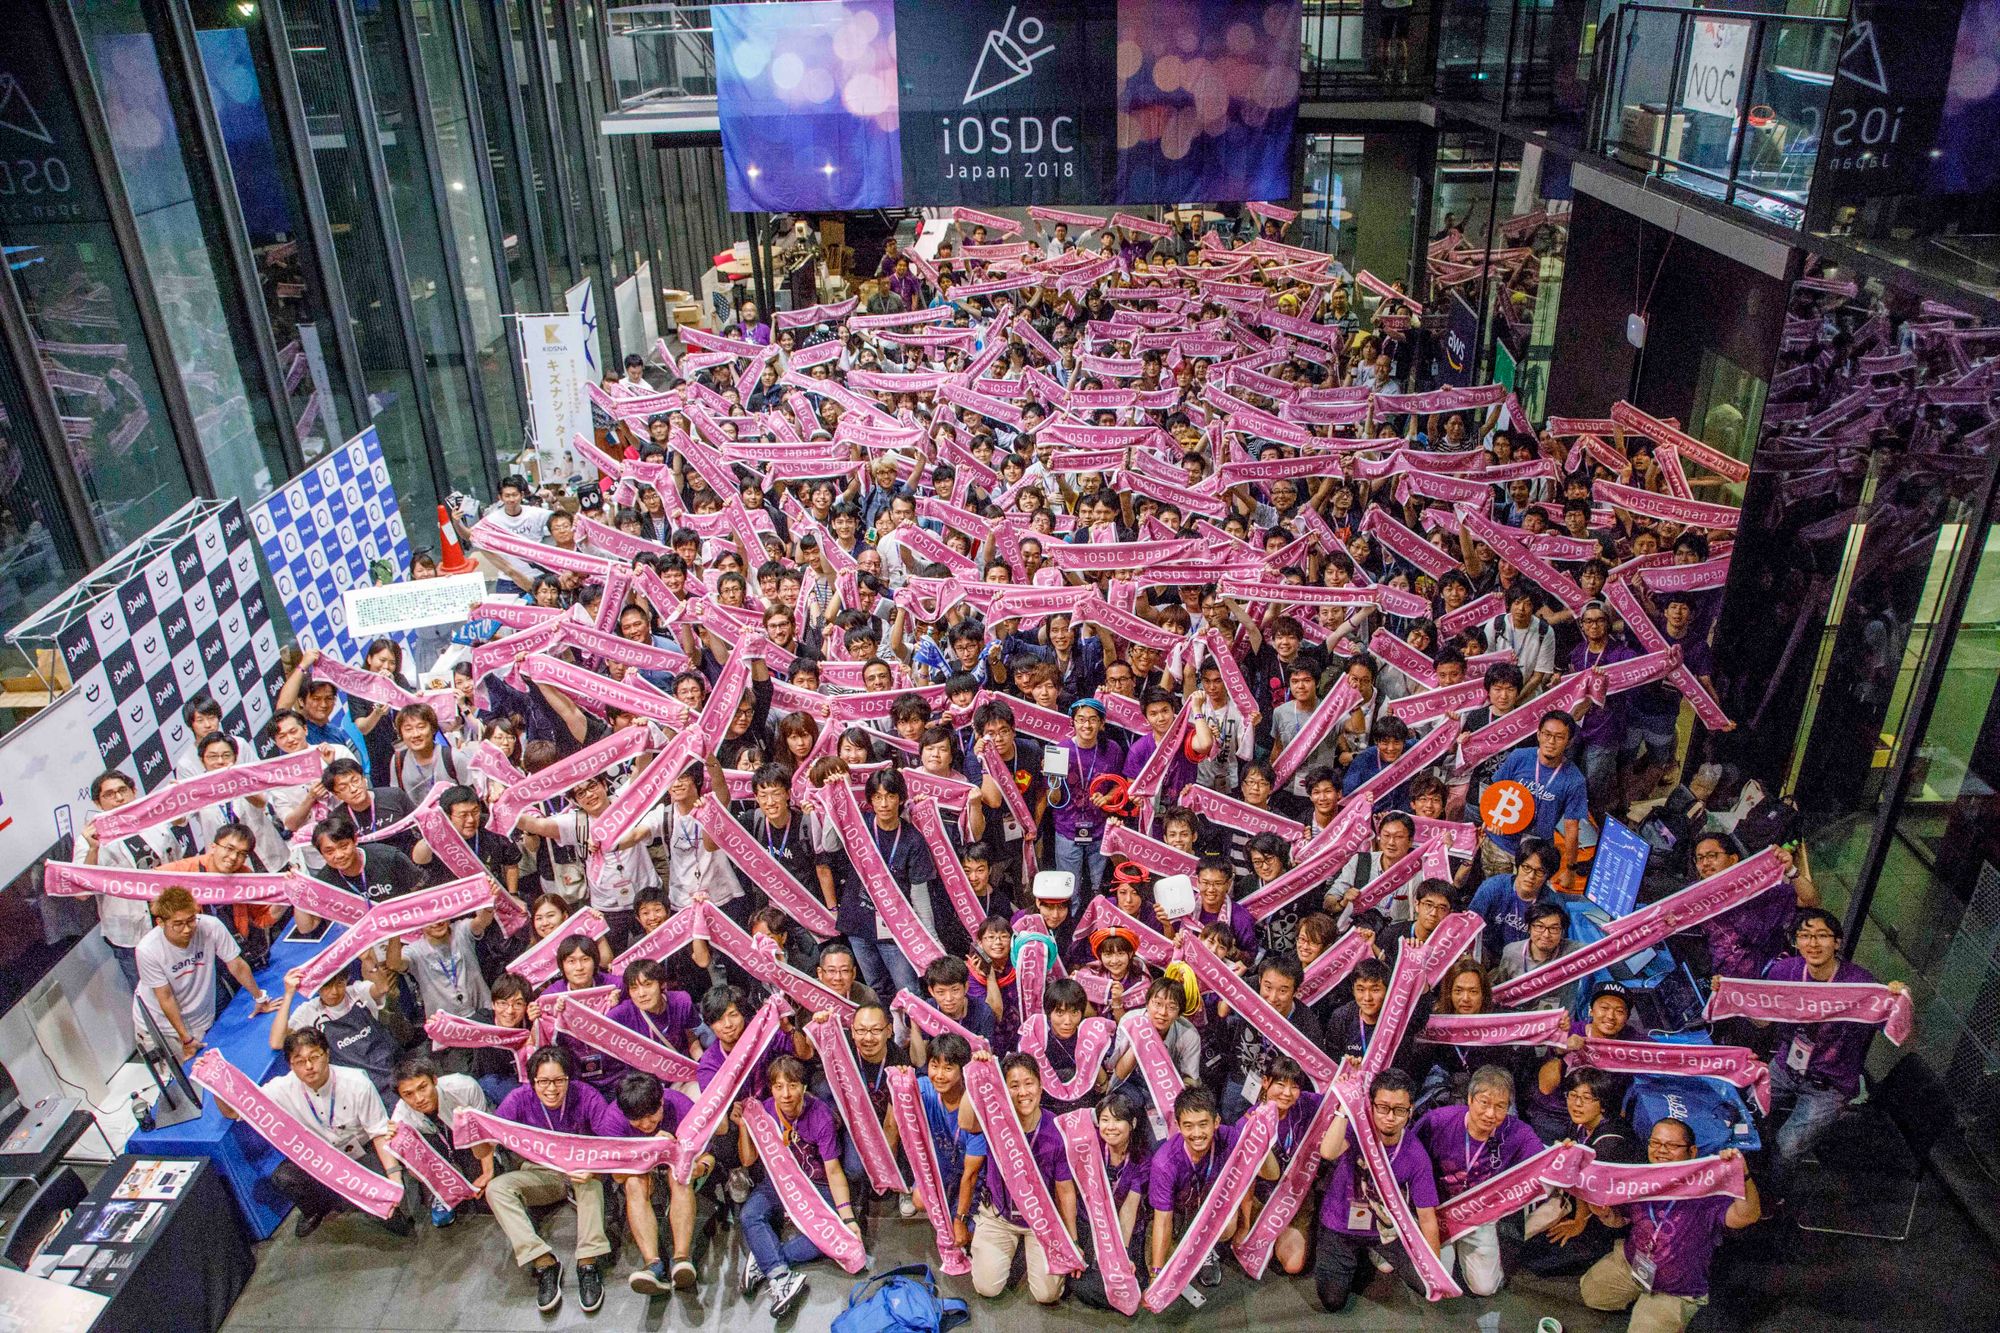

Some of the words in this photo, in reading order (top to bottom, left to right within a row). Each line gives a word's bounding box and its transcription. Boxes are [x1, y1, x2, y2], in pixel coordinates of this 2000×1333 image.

[1687, 64, 1735, 107] NOC
[942, 116, 1074, 154] iOSDC
[946, 162, 1010, 180] Japan
[1023, 162, 1074, 178] 2018
[1448, 330, 1466, 360] aws
[547, 360, 567, 448] キズナシッター
[1481, 523, 1515, 556] iOSDC
[1514, 556, 1551, 587] Japan
[459, 620, 492, 641] LGTM
[1625, 612, 1660, 650] iOSDC
[581, 676, 628, 702] Japan
[714, 673, 739, 720] Japan
[774, 686, 822, 712] iOSDC
[1440, 687, 1485, 712] Japan
[1484, 717, 1527, 749] iOSDC
[1533, 692, 1573, 725] Japan
[514, 771, 562, 803] iOSDC
[569, 745, 618, 774] Japan
[638, 757, 679, 801] Japan
[147, 788, 198, 819] iOSDC
[1232, 807, 1278, 833] Japan
[725, 832, 764, 869] iOSDC
[760, 868, 797, 903] Japan
[844, 822, 874, 869] iOSDC
[868, 872, 899, 917] Japan
[432, 889, 472, 910] 2018
[1362, 874, 1400, 908] iOSDC
[1683, 889, 1729, 917] Japan
[1425, 927, 1460, 972] iOSDC
[1504, 972, 1551, 1000] iOSDC
[1561, 948, 1608, 976] Japan
[801, 988, 844, 1017] Japan
[652, 1051, 694, 1079] iOSDC
[1677, 1051, 1737, 1071] Japan
[690, 1087, 727, 1134] iOSDC
[238, 1091, 286, 1135] iOSDC
[283, 1131, 333, 1175] Japan
[336, 1170, 377, 1198] 2018
[502, 1133, 556, 1159] iOSDC
[429, 1156, 461, 1199] iOSDC
[755, 1114, 785, 1167] iOSDC
[781, 1173, 814, 1218] Japan
[813, 1216, 849, 1256] 2018
[999, 1128, 1028, 1178] Japan
[1018, 1183, 1052, 1234] iOSDC
[1211, 1166, 1242, 1218] Japan
[1237, 1121, 1267, 1165] 2018
[1606, 1176, 1662, 1196] Japan
[1498, 1177, 1541, 1205] Japan
[1267, 1187, 1304, 1235] iOSDC
